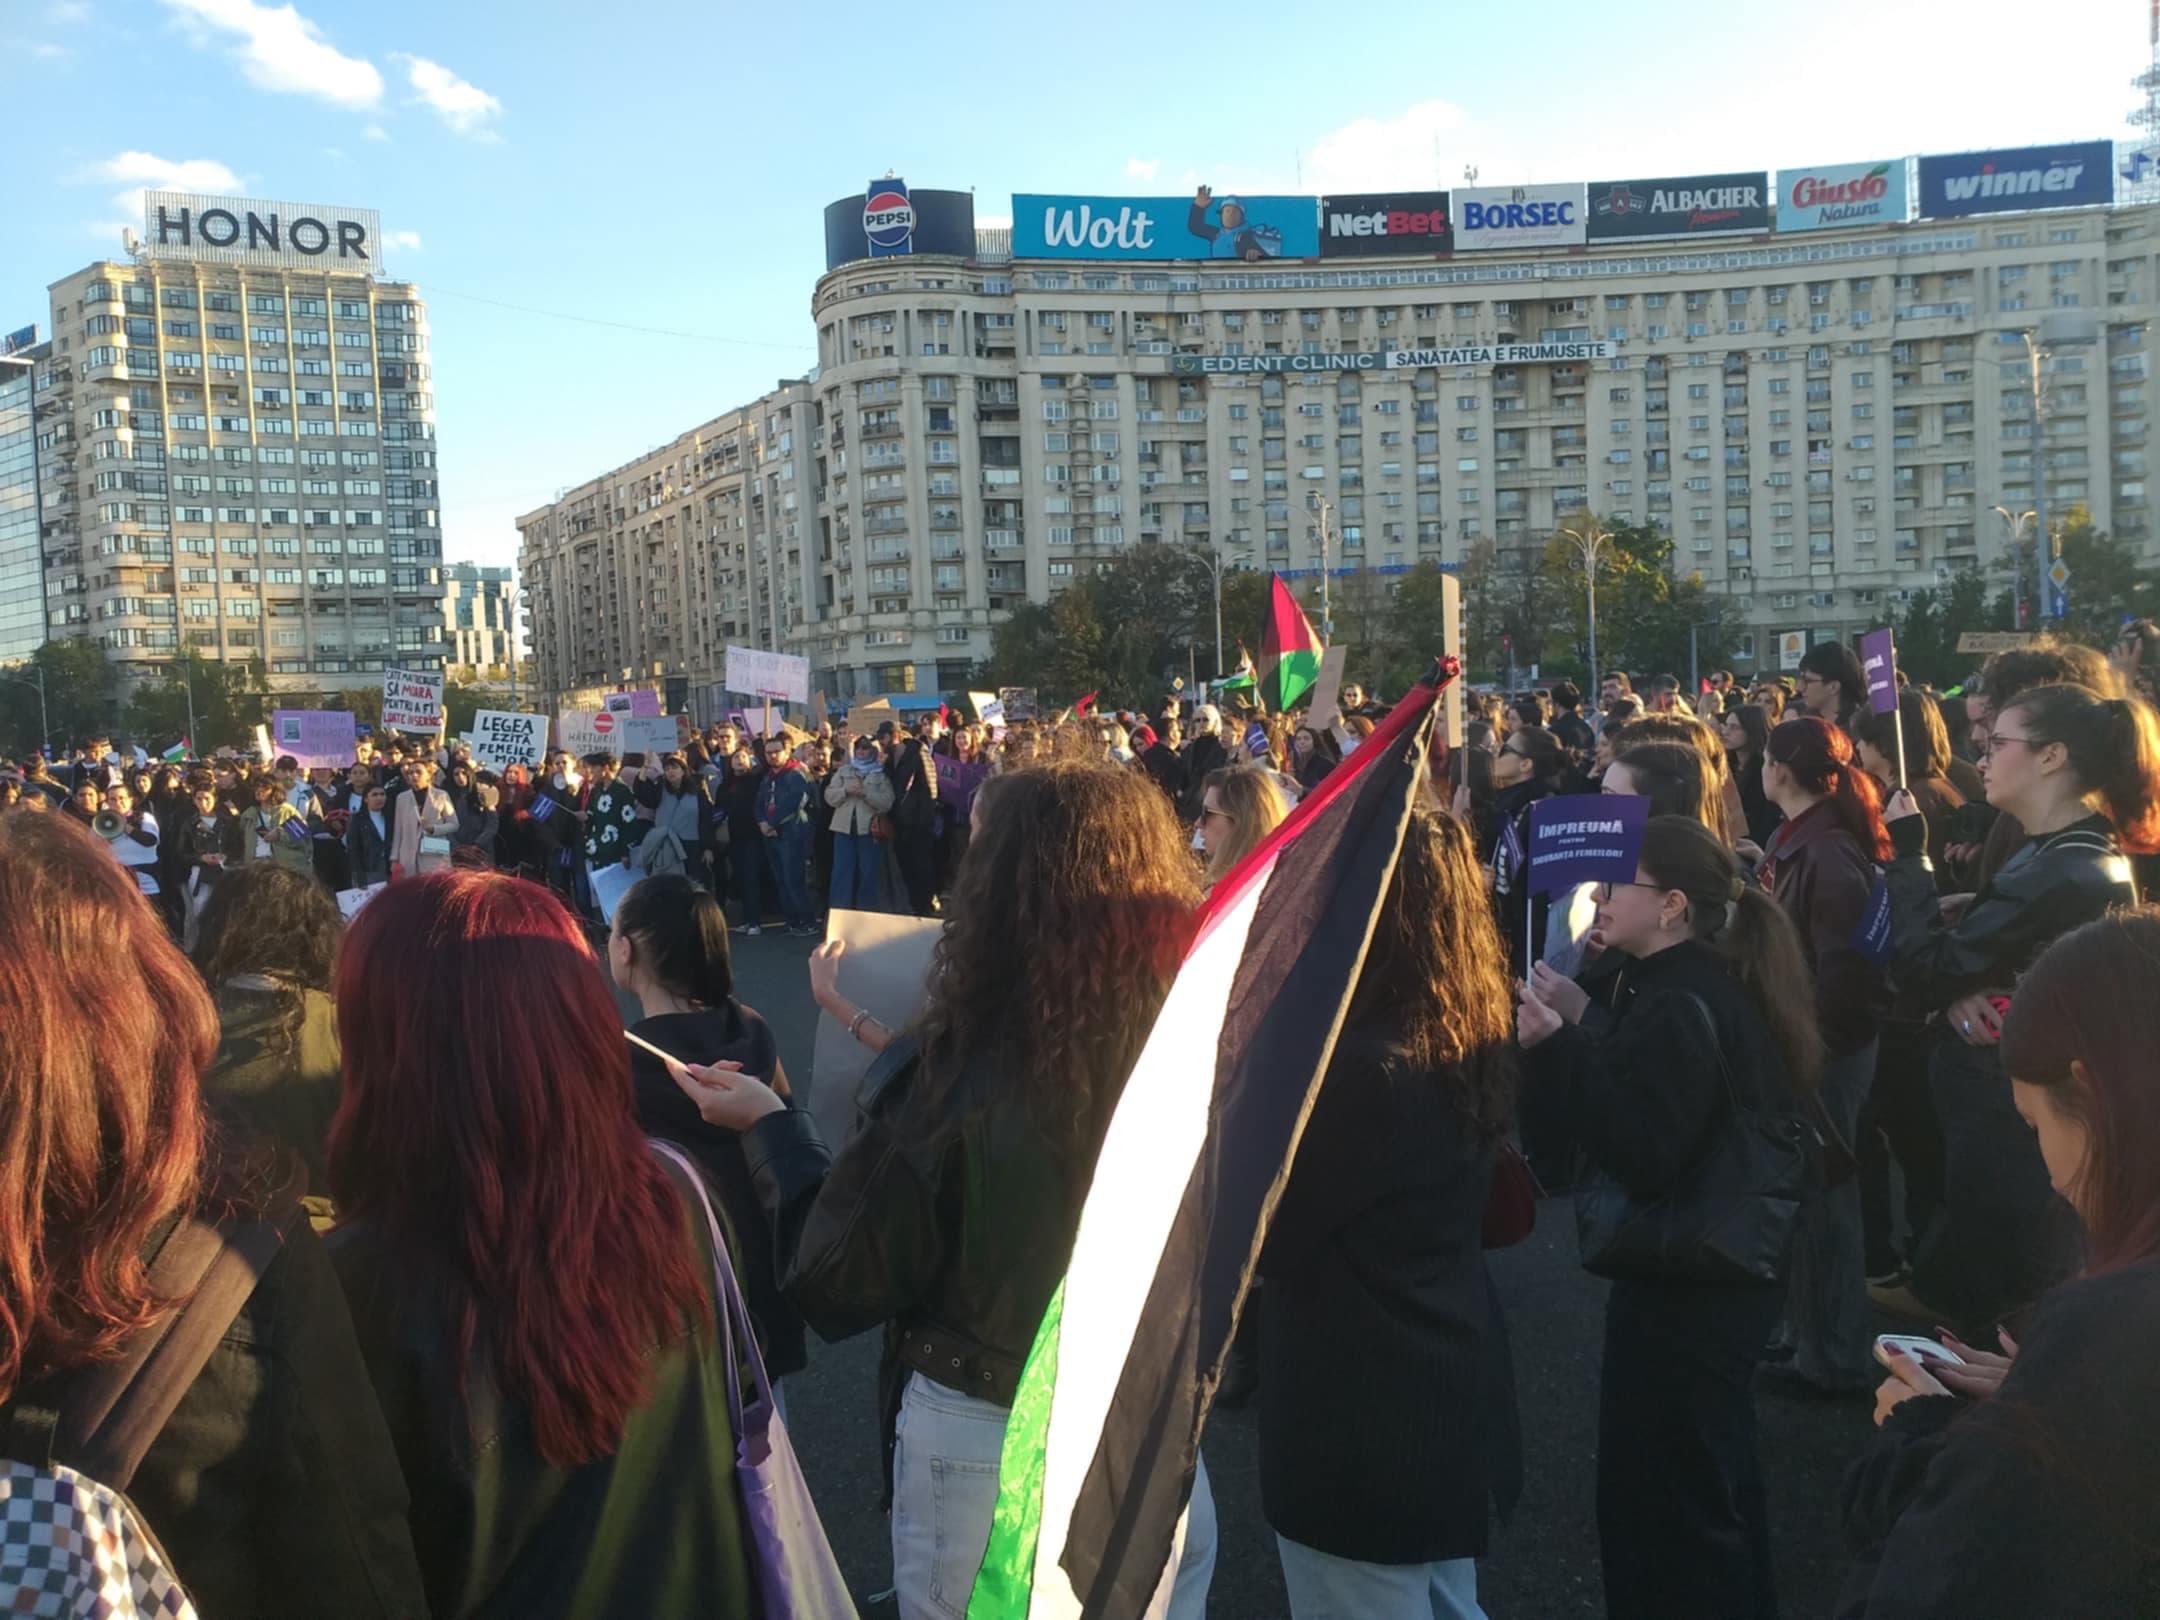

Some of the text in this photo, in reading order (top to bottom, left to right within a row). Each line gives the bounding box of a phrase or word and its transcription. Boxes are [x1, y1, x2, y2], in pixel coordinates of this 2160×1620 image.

[1792, 172, 1888, 209] Giusto
[1945, 162, 2084, 202] winner
[1650, 186, 1762, 214] ALBACHER
[866, 211, 911, 226] PEPSI
[1329, 209, 1445, 237] NetBet
[1463, 201, 1575, 231] BORSEC
[1818, 202, 1880, 225] Natura
[158, 206, 369, 259] HONOR
[1043, 205, 1155, 249] Wolt
[1202, 354, 1374, 372] EDENT CLINIC
[1495, 347, 1504, 360] E
[482, 716, 534, 734] LEGEA
[478, 743, 536, 757] FEMEILE
[494, 755, 530, 765] MOR
